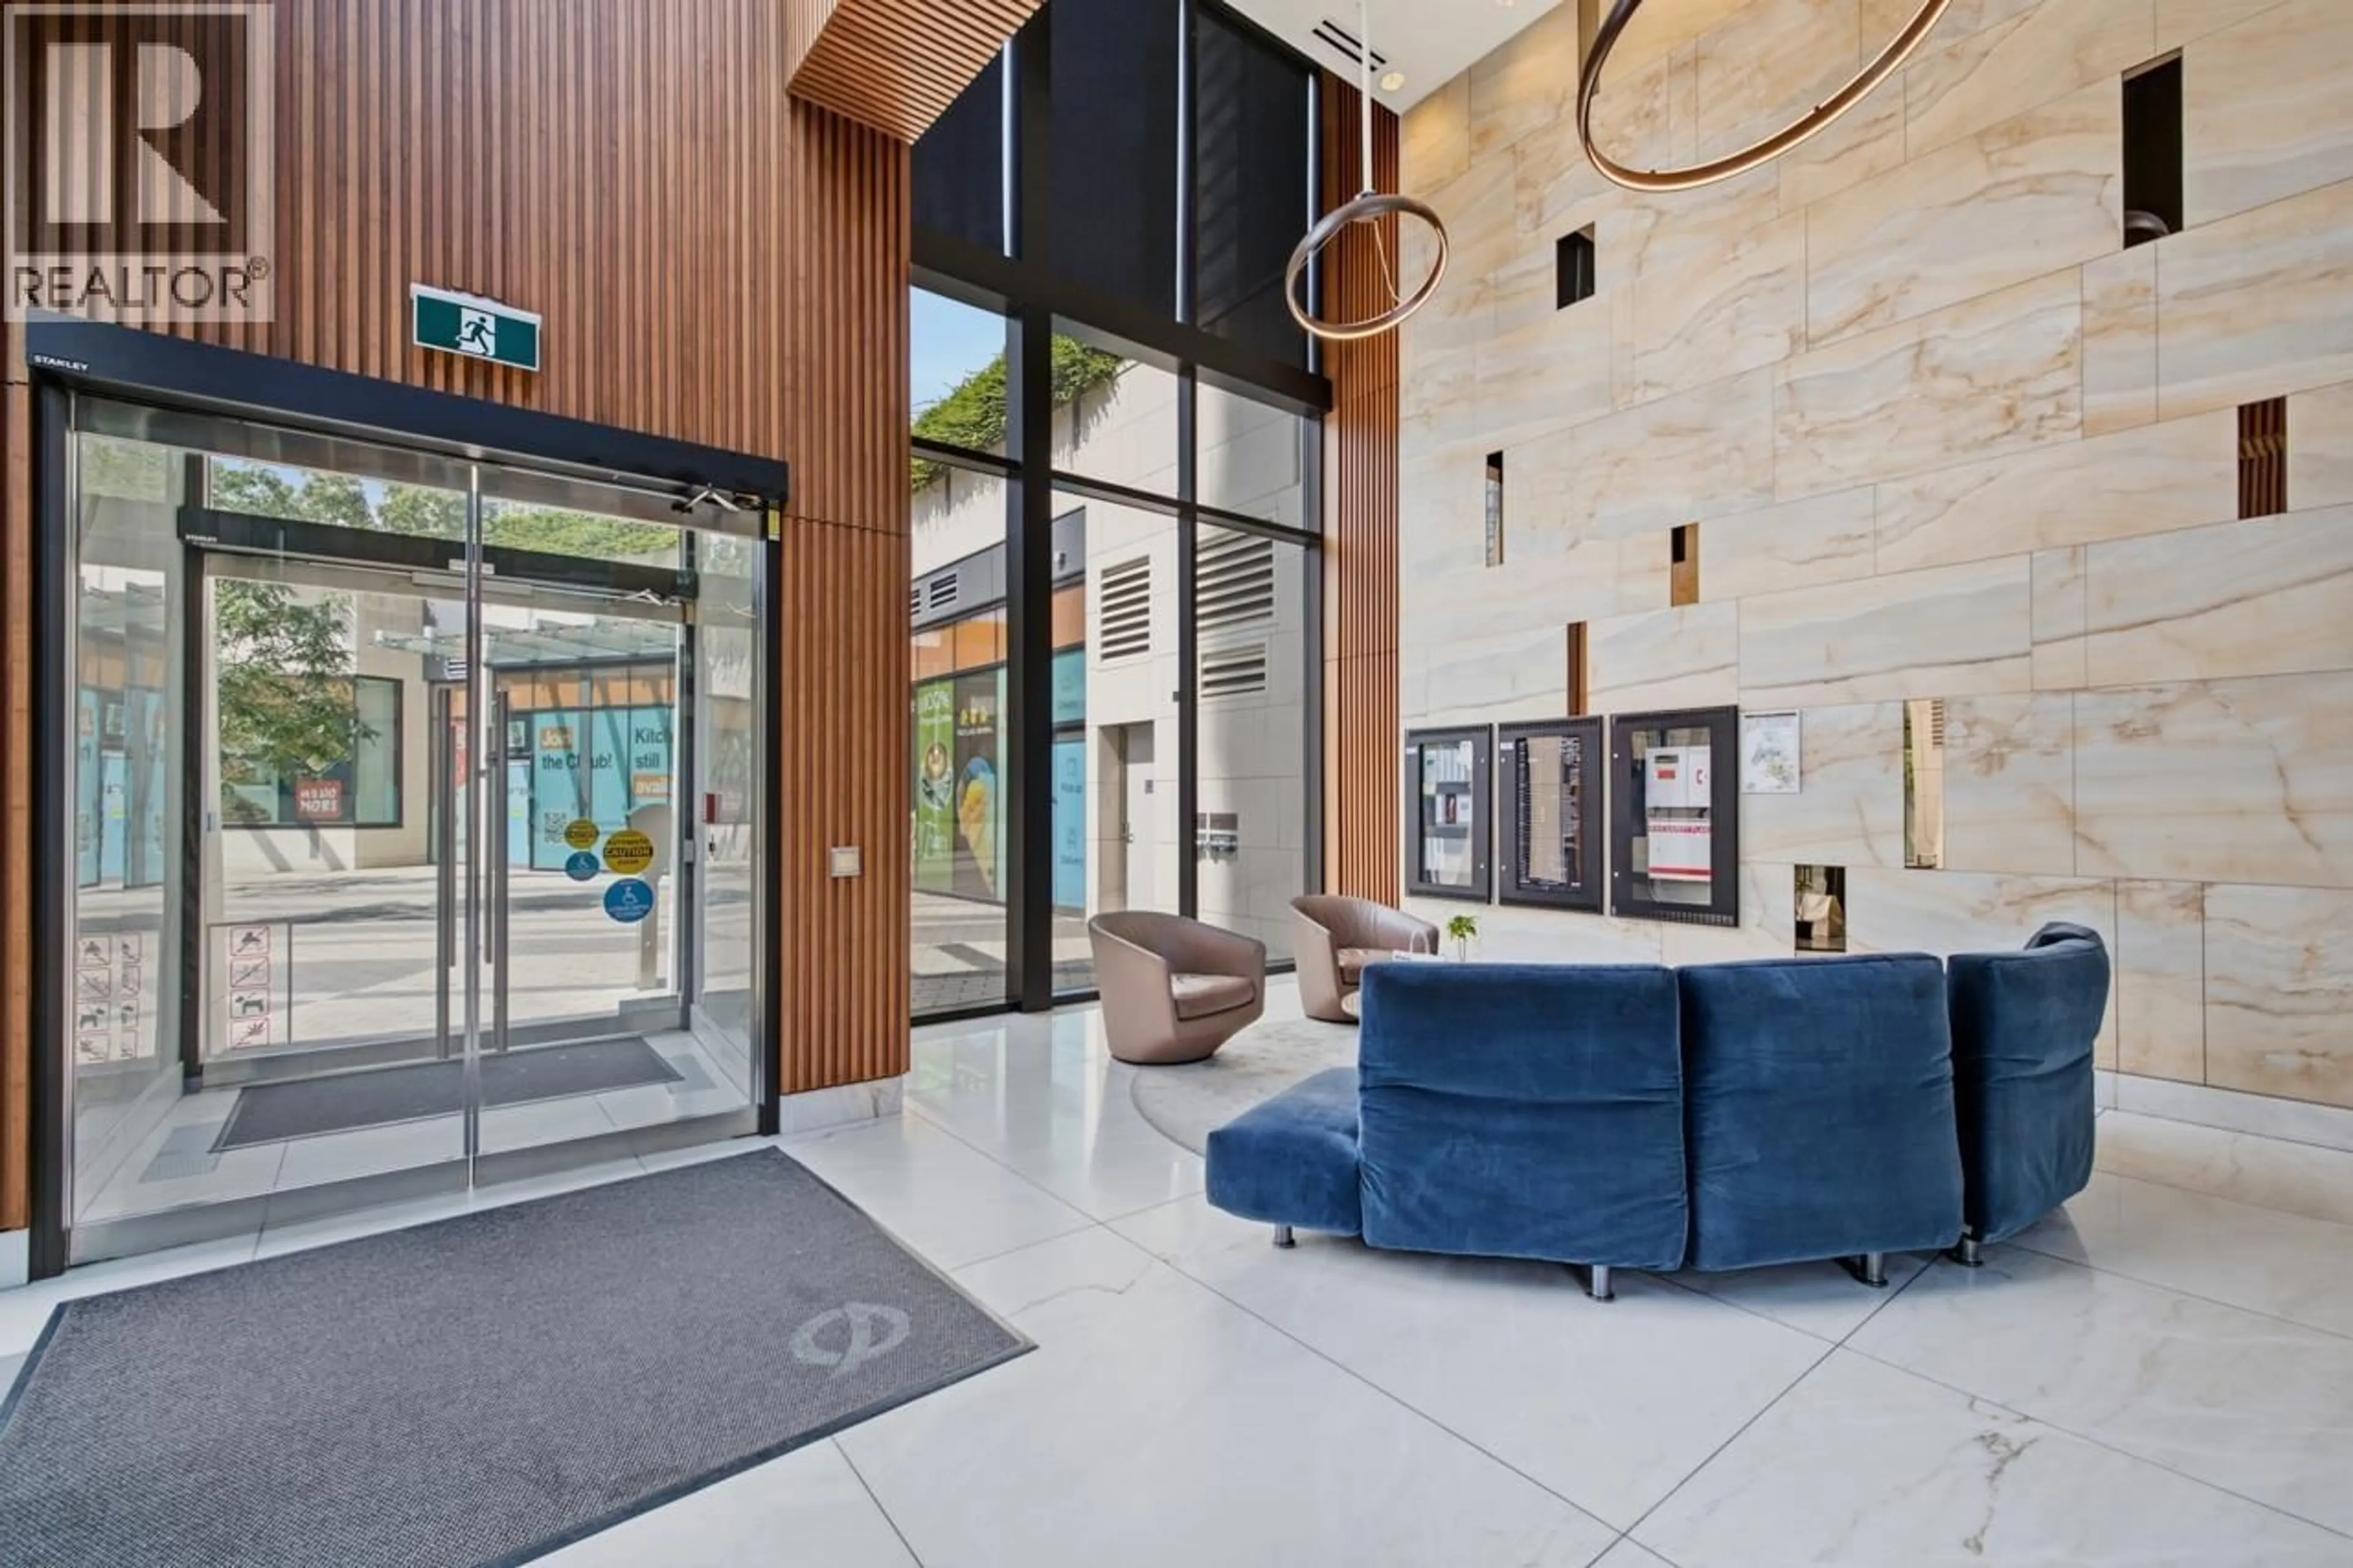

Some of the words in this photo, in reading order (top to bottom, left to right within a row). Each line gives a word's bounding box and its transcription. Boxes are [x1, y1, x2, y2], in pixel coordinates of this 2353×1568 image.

[33, 354, 89, 371] STANLEY
[542, 753, 563, 770] the
[635, 752, 661, 769] still
[604, 846, 651, 857] CAUTION
